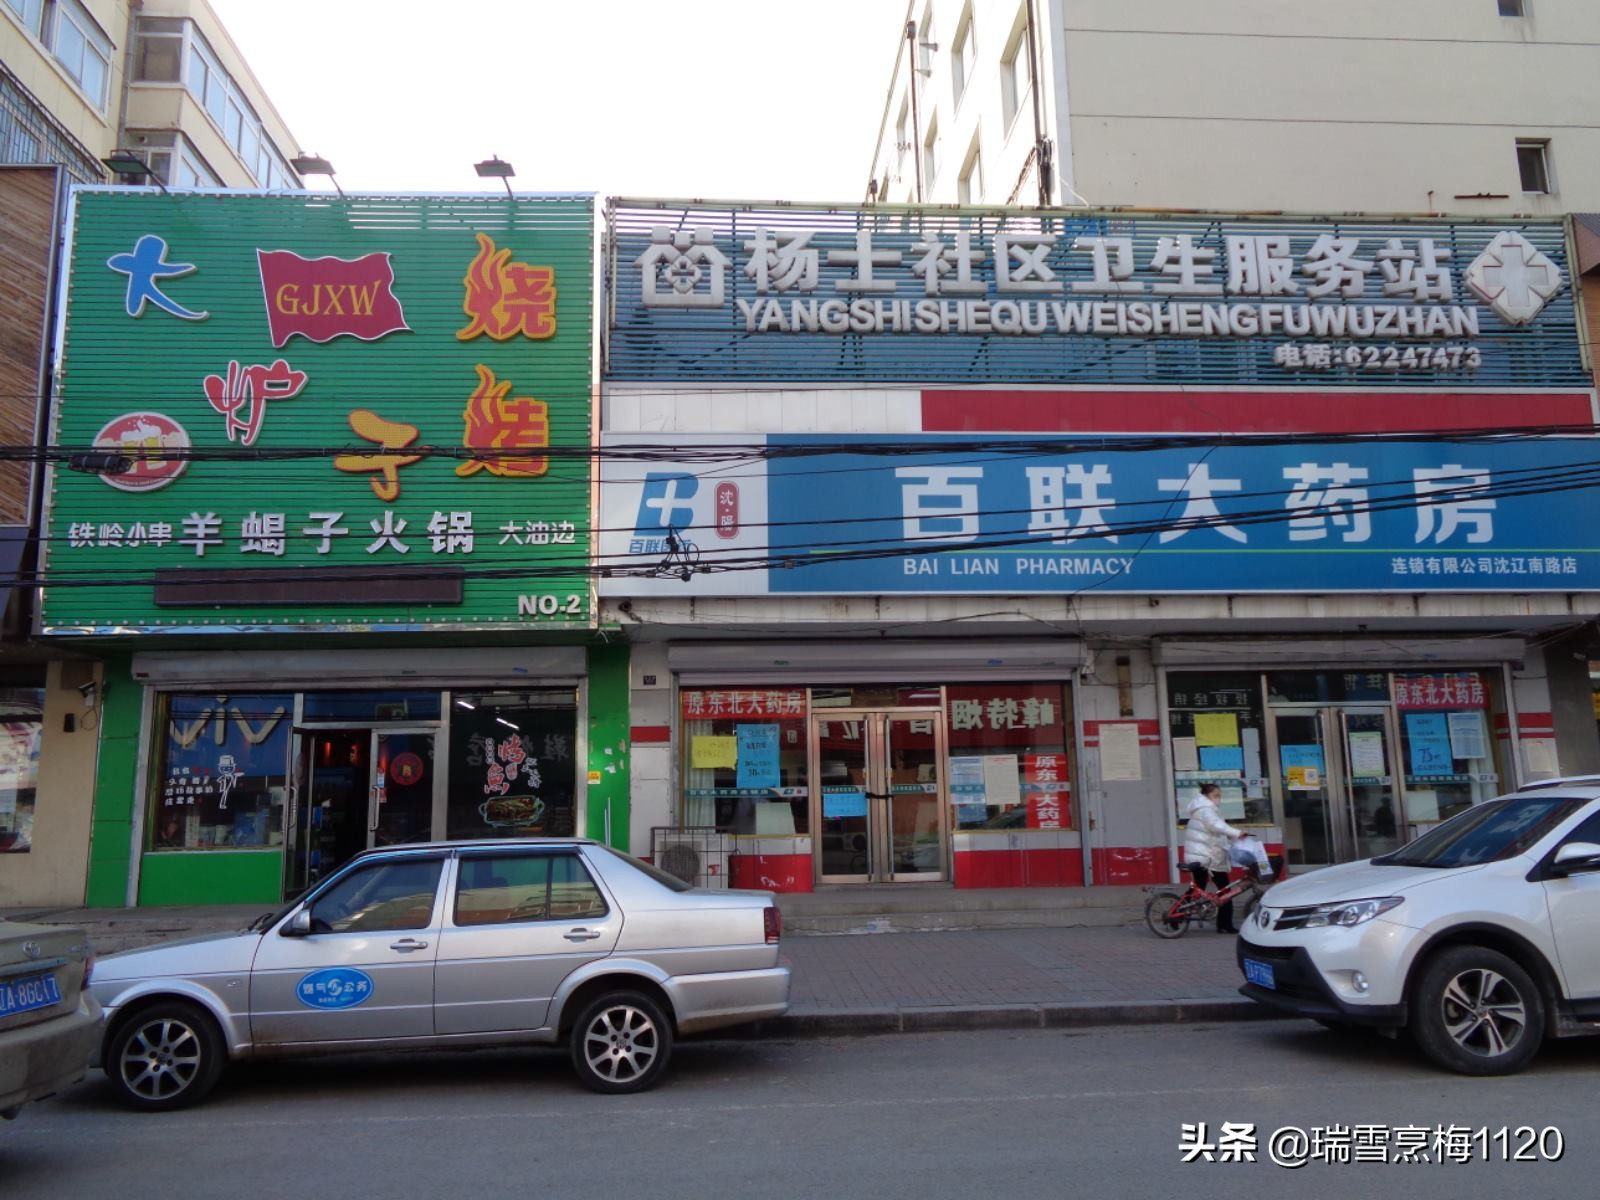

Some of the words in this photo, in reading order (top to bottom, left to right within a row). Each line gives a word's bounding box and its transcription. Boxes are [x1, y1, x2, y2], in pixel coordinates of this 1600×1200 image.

[743, 226, 1456, 301] 杨士社区卫生服务站
[276, 280, 382, 316] GJXW
[106, 234, 210, 321] 大
[203, 359, 308, 446] 炉
[333, 408, 431, 502] 子
[455, 232, 558, 478] 烧烤
[895, 462, 1498, 545] 百联大药房
[68, 521, 172, 548] 铁岭小串
[178, 510, 475, 556] 羊蝎子火锅
[499, 520, 576, 545] 大油边
[903, 558, 938, 575] BAI
[951, 558, 999, 575] LIAN
[1016, 558, 1134, 575] PHARMACY
[1391, 557, 1577, 575] 连锁有限公司沈辽南路店
[687, 691, 804, 715] 原东北大药房
[1396, 683, 1485, 705] 原东北大药房
